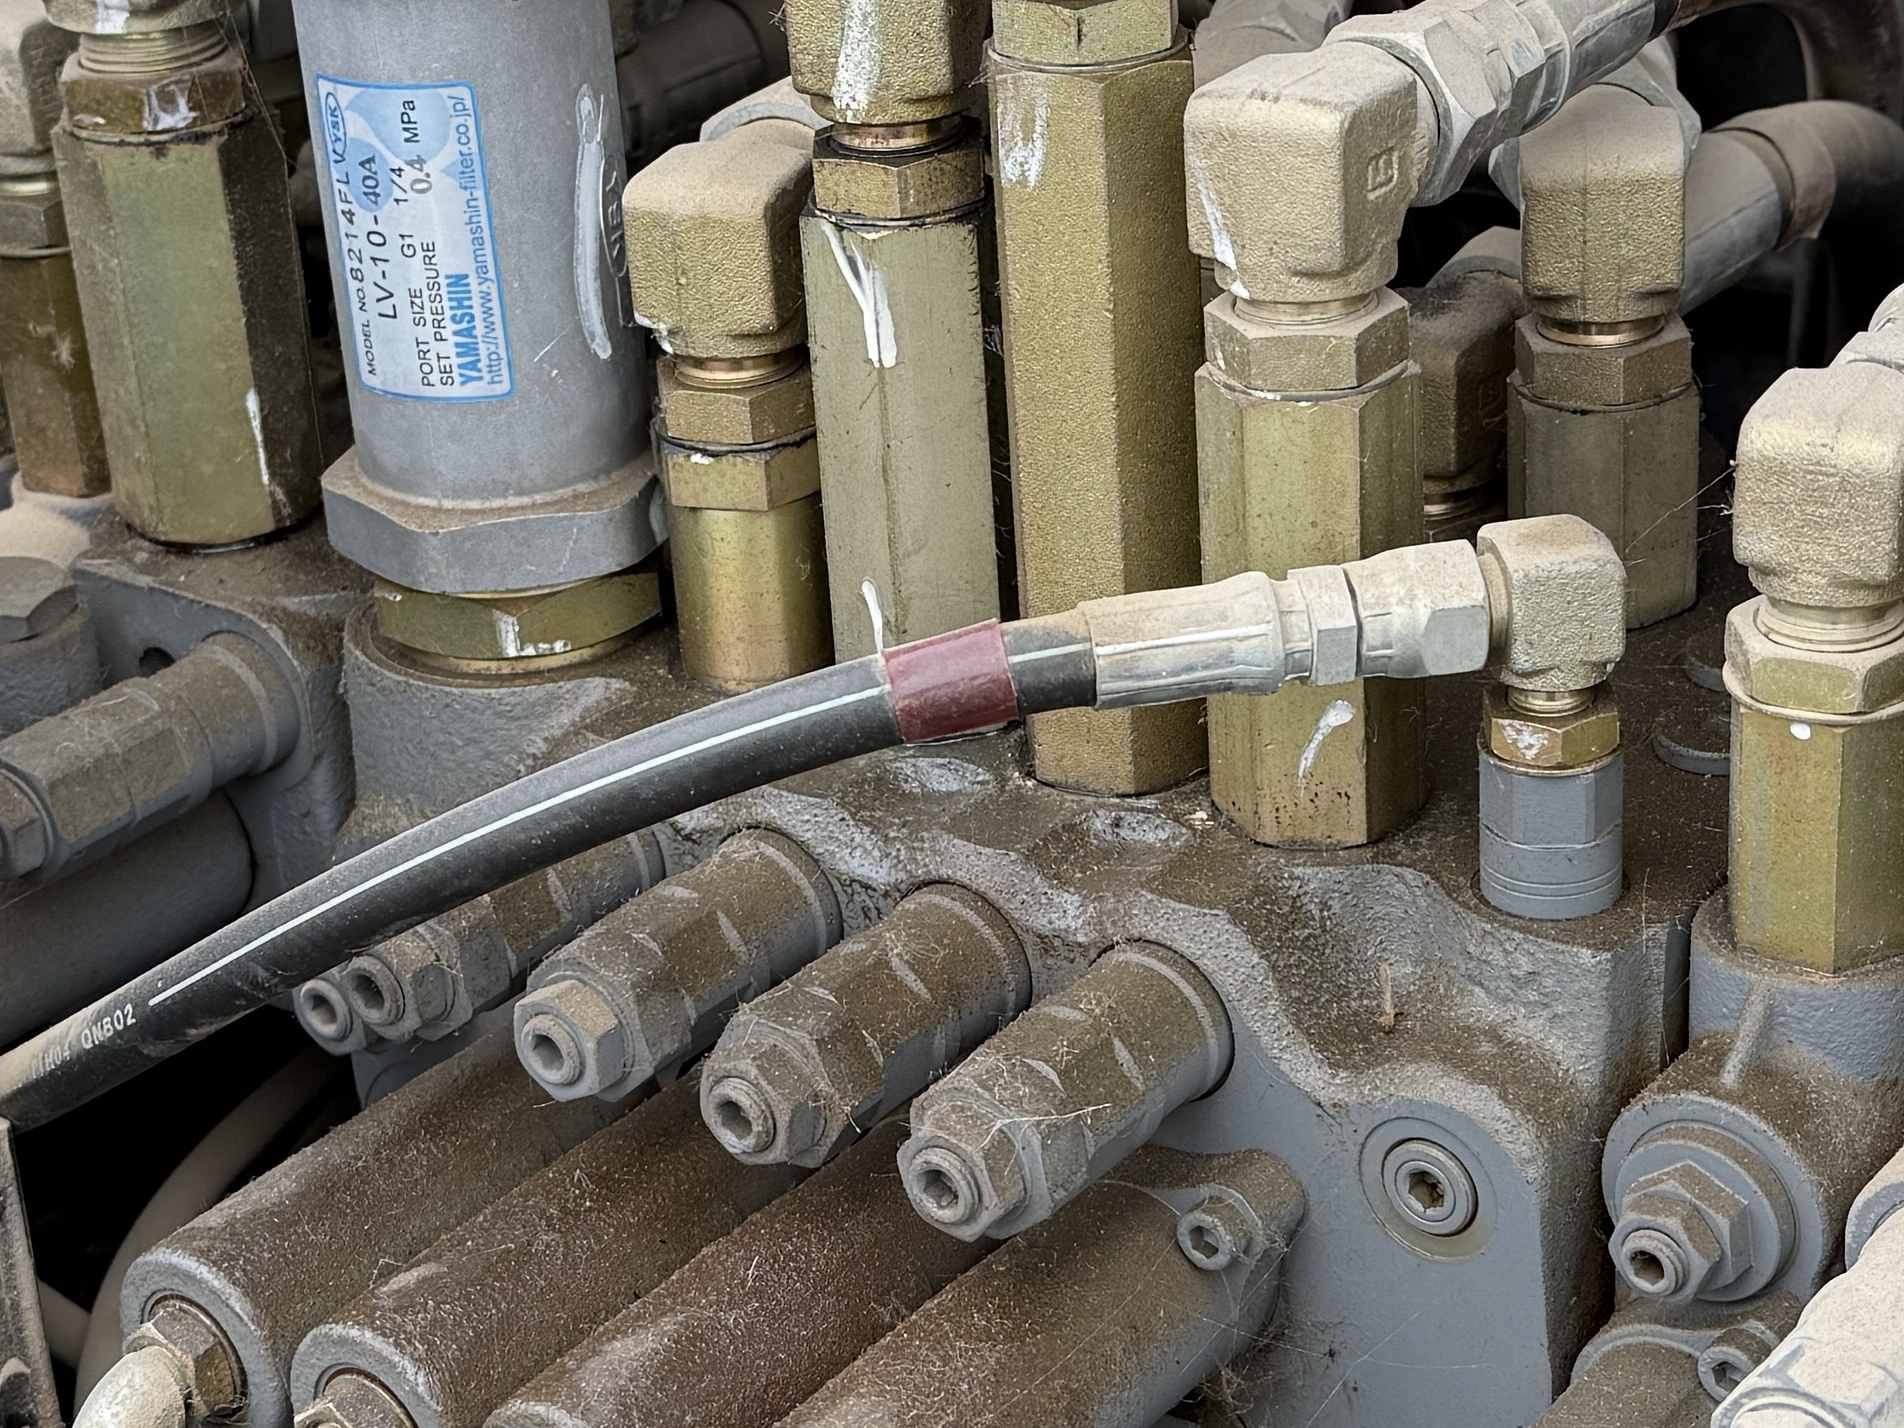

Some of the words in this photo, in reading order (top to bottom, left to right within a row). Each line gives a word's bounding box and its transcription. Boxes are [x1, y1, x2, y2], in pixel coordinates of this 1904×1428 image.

[327, 104, 343, 144] YSK
[400, 100, 421, 144] MPa
[389, 166, 409, 206] 1/4
[404, 154, 433, 195] 0.4
[398, 233, 417, 259] G1
[447, 95, 504, 385] http://www.yamashin-filter.co.jp/
[408, 287, 427, 327] SIZE
[421, 241, 449, 342] PRESSURE
[360, 319, 377, 376] MODEL
[444, 273, 484, 387] YAMASHIN
[415, 337, 436, 387] PORT
[436, 352, 455, 387] SET
[80, 1002, 137, 1050] QNB02
